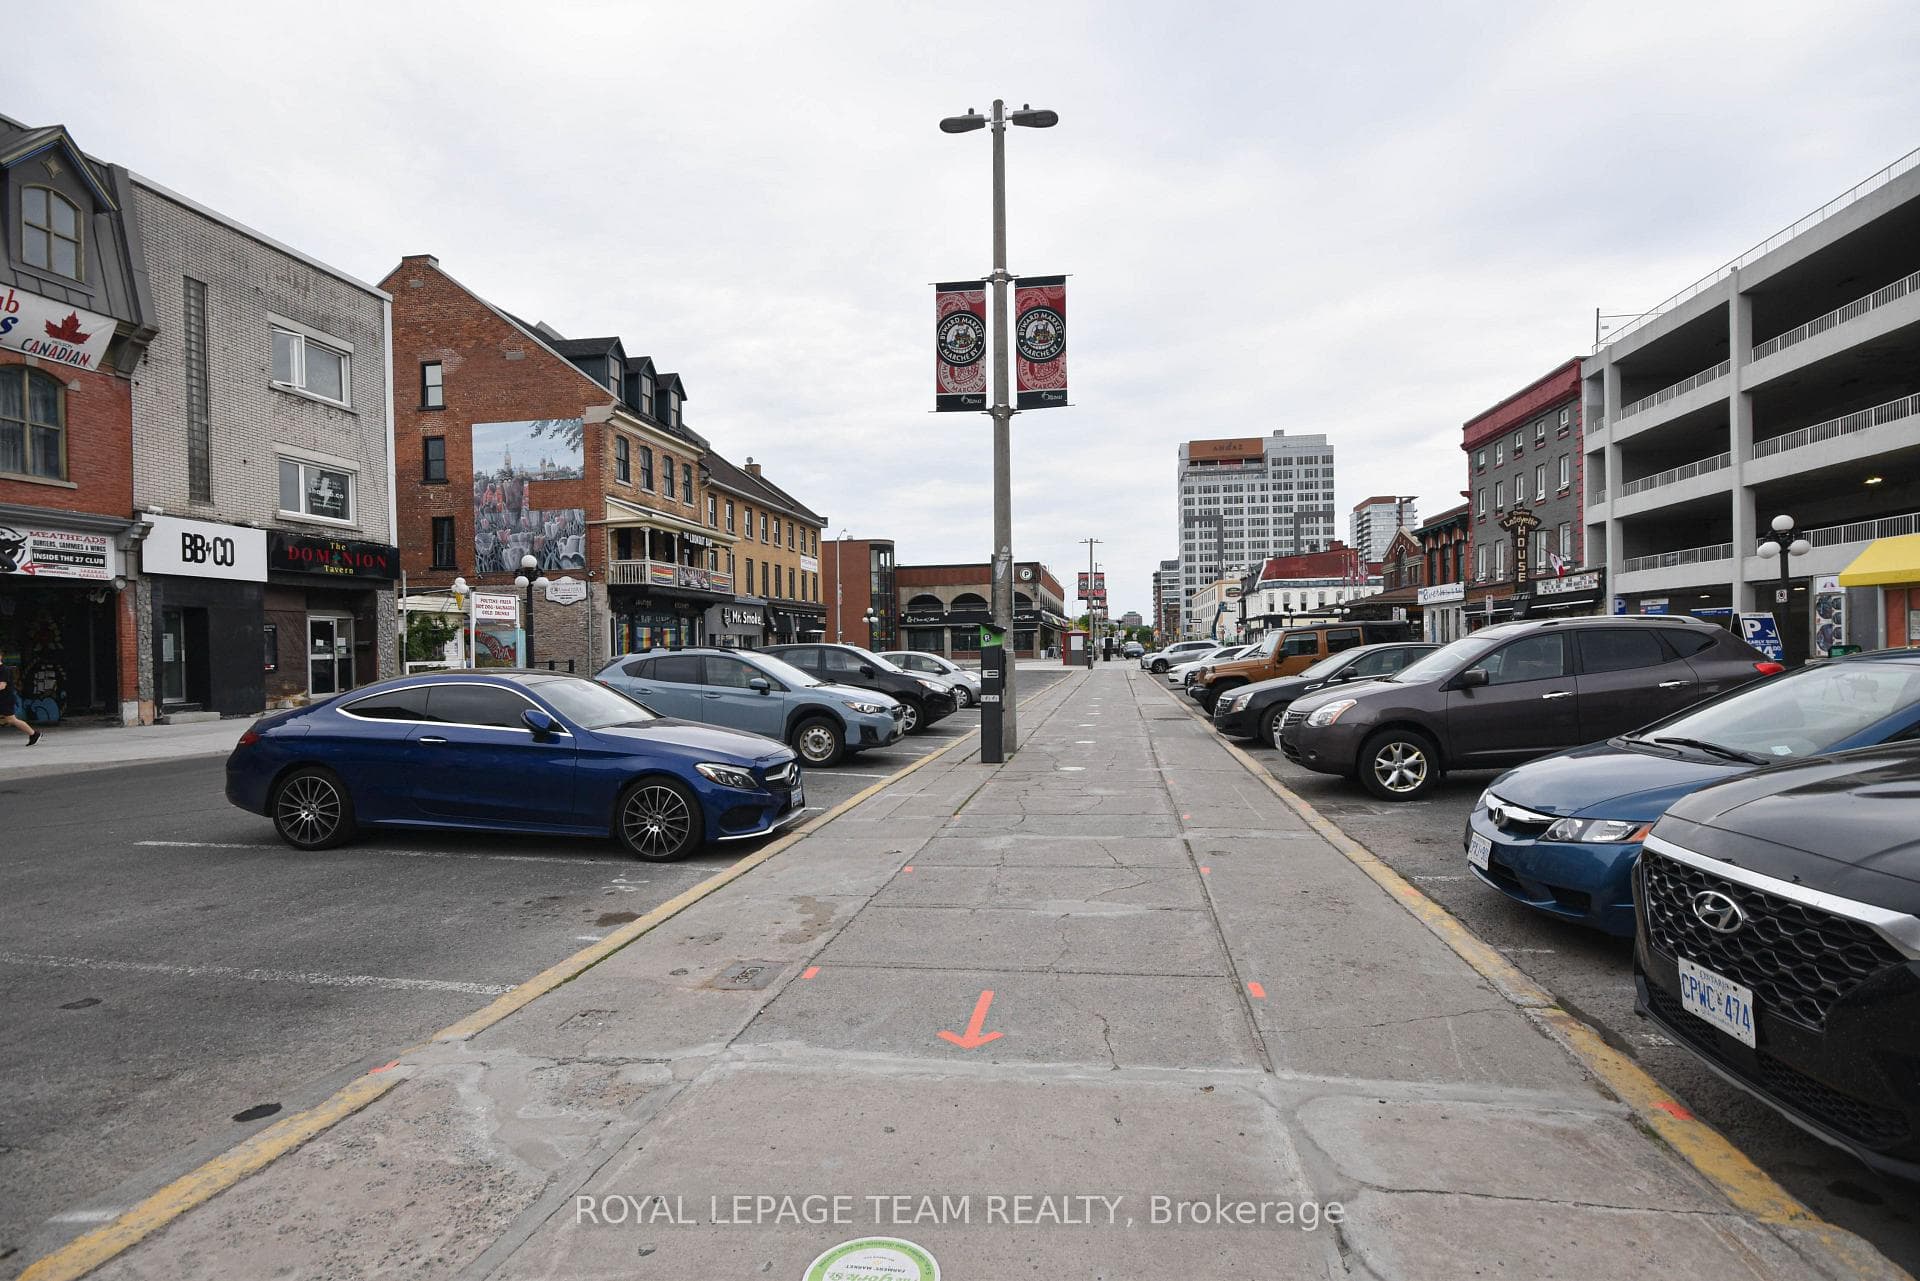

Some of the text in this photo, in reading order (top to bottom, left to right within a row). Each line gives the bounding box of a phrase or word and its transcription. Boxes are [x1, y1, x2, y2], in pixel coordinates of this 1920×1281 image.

[940, 316, 983, 340] BYWARD MARKET
[1019, 312, 1063, 336] BYWARD MARKET
[20, 338, 91, 367] CANADIAN
[1503, 515, 1538, 527] Lafayette
[29, 531, 107, 544] MEATHEADS
[329, 542, 347, 550] The
[33, 552, 59, 560] INSIDE
[60, 554, 74, 562] THE
[85, 556, 104, 565] CLUB
[287, 545, 388, 569] DOMNION
[1517, 526, 1526, 582] HOUSE
[323, 564, 354, 574] Tavern
[1614, 599, 1626, 613] P
[732, 609, 762, 624] Mr. Smoke
[1743, 619, 1761, 638] P
[1699, 970, 1731, 989] ONTARIO
[1681, 973, 1716, 1012] CPWC
[1725, 994, 1751, 1031] 474
[845, 1264, 873, 1272] MARKET
